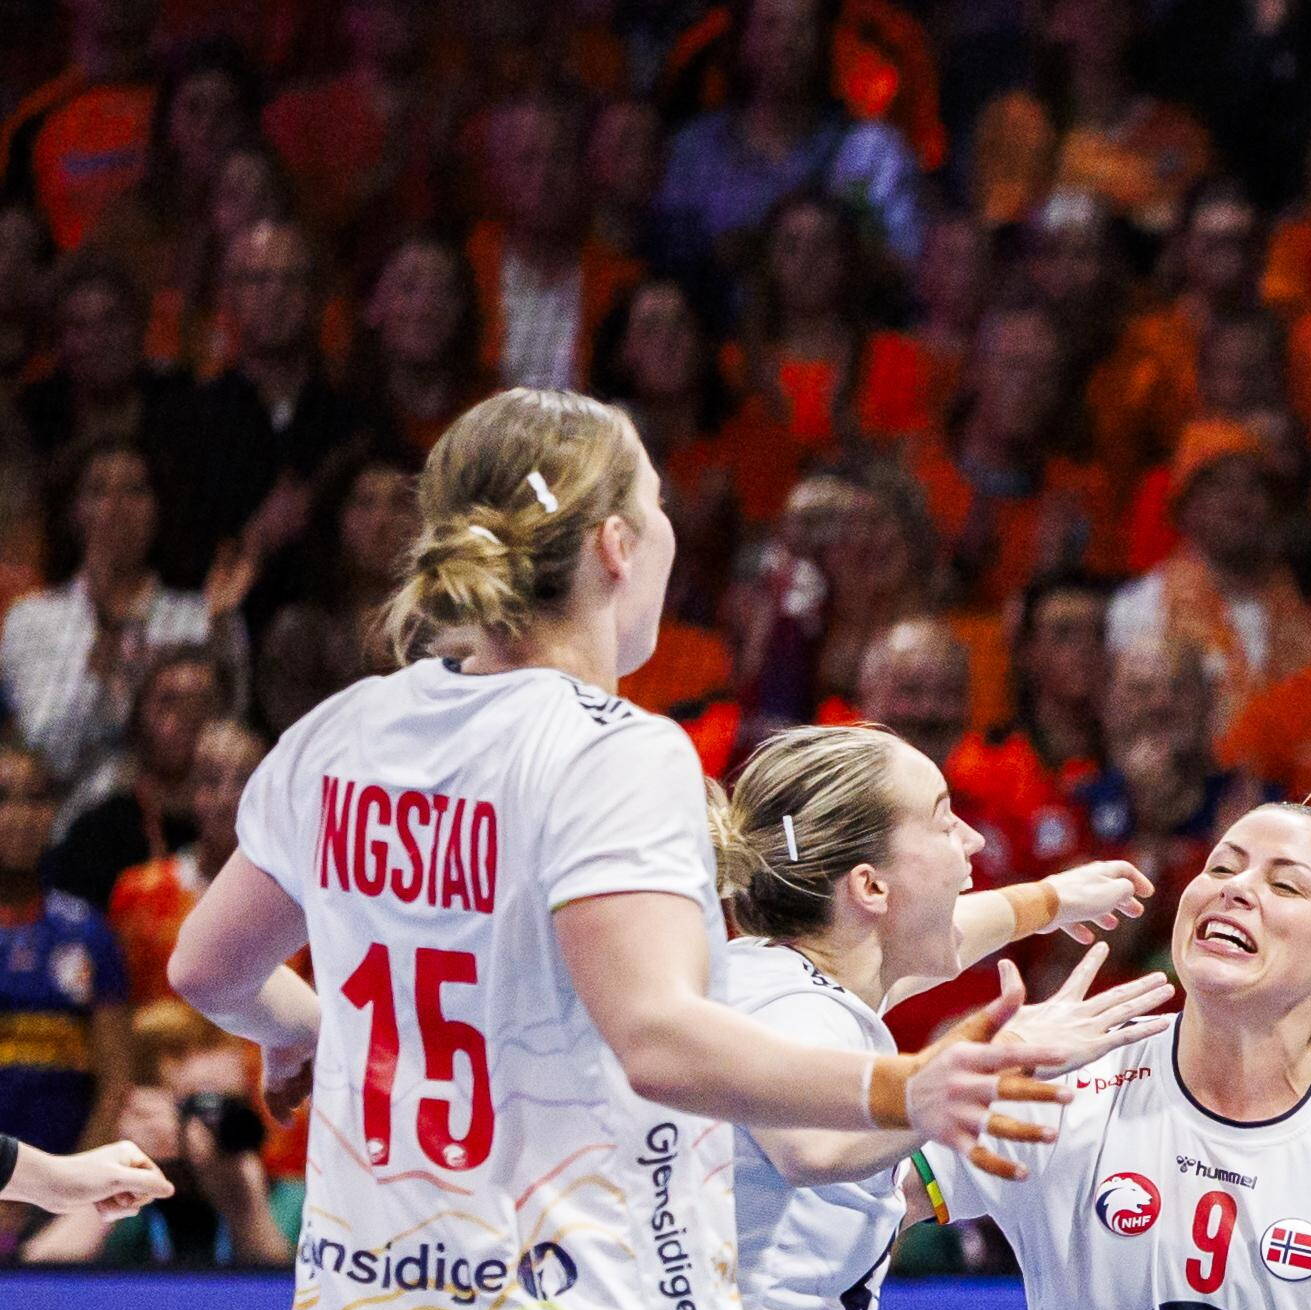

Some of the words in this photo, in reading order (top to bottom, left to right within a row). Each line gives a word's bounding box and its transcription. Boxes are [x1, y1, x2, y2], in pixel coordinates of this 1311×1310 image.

[340, 941, 495, 1171] 15
[1196, 1161, 1258, 1190] hummel
[1120, 1214, 1152, 1230] NHF
[1185, 1190, 1237, 1294] 9
